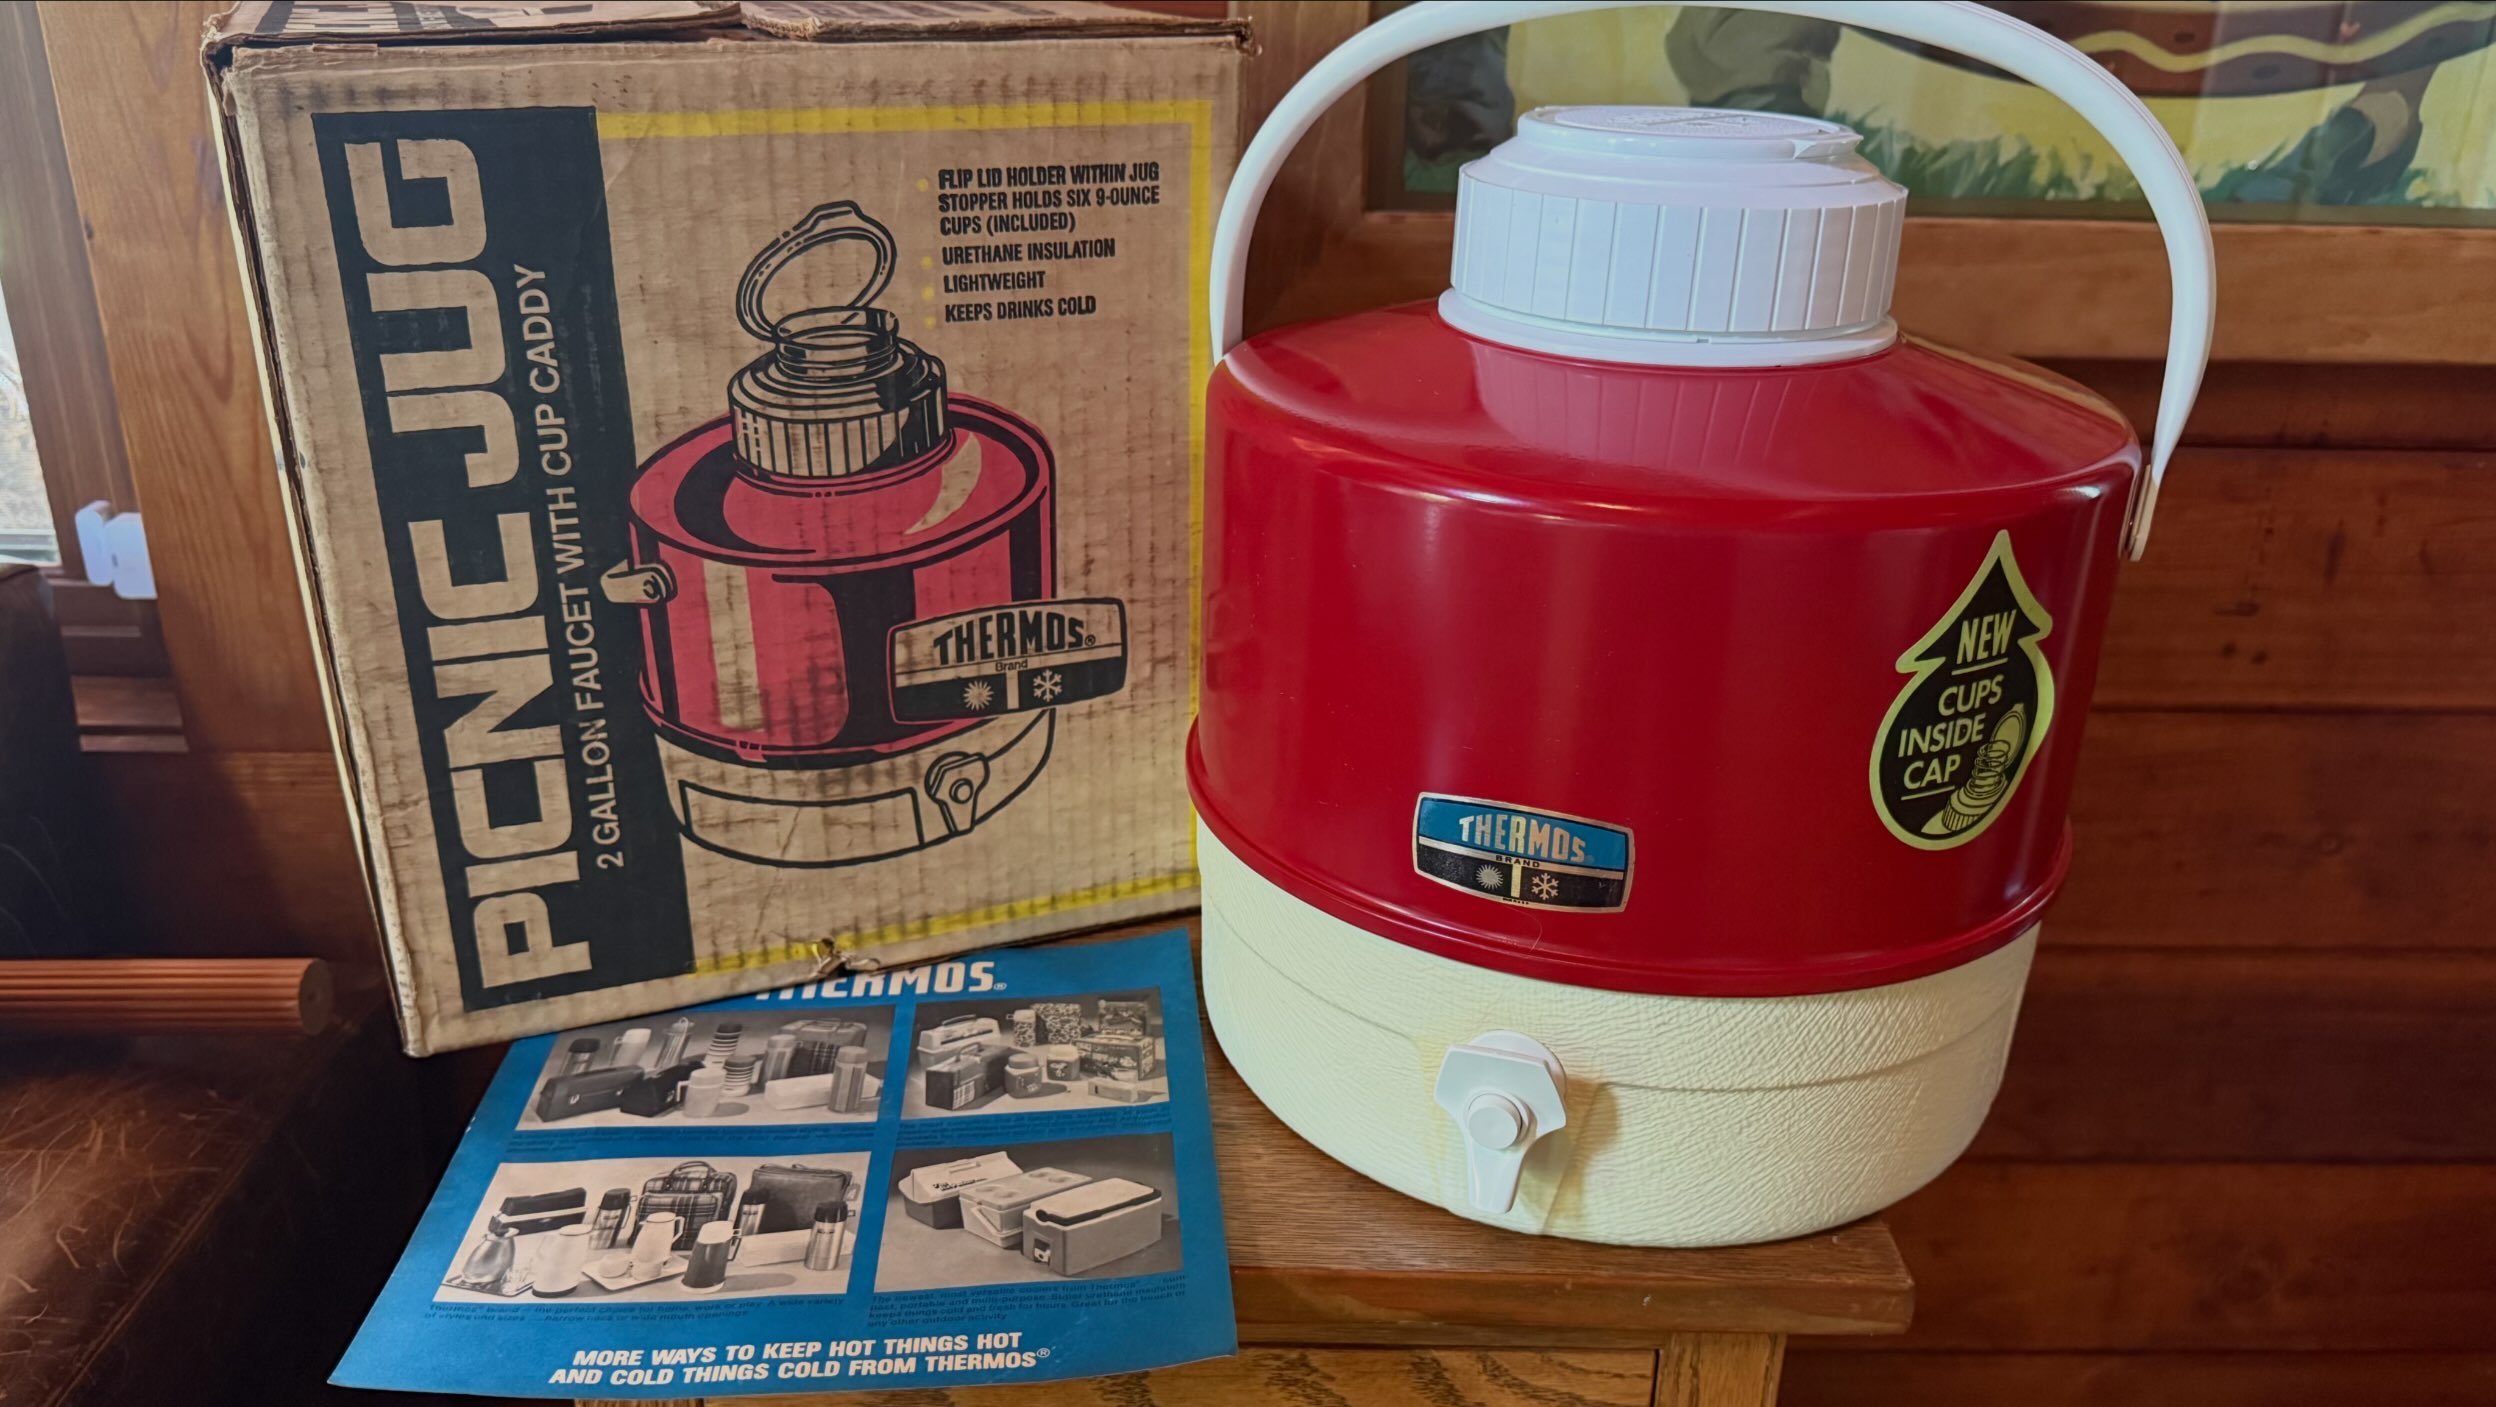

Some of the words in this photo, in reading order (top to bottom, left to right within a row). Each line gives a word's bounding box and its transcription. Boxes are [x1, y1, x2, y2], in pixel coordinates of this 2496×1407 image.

[938, 168, 972, 190] FLIP
[977, 167, 1003, 188] LID
[1007, 165, 1066, 187] HOLDER
[1070, 163, 1126, 184] WITHIN
[1129, 161, 1159, 182] JUG
[938, 191, 1008, 213] STOPPER
[1012, 189, 1062, 210] HOLDS
[1066, 187, 1091, 208] SIX
[1095, 185, 1160, 207] 9-OUNCE
[940, 215, 982, 236] CUPS
[986, 212, 1076, 237] (INCLUDED)
[942, 243, 1023, 266] URETHANE
[1027, 238, 1116, 262] INSULATION
[943, 270, 1046, 293] LIGHTWEIGHT
[344, 138, 520, 488] JUG
[945, 303, 992, 323] KEEPS
[997, 298, 1054, 321] DRINKS
[1058, 295, 1096, 316] COLD
[513, 263, 561, 394] CADDY
[534, 403, 573, 477] CUP
[546, 485, 582, 574] WITH
[558, 583, 606, 712] FAUCET
[1956, 609, 2017, 666] NEW
[995, 660, 1028, 672] Brand
[1938, 674, 2005, 717] CUPS
[408, 512, 593, 989] PICNIC
[1898, 713, 1987, 758] INSIDE
[574, 716, 621, 846] GALLON
[1903, 754, 1961, 790] CAP
[596, 844, 625, 870] 2
[1495, 855, 1540, 868] BRAND
[572, 1350, 645, 1367] MORE
[651, 1346, 717, 1366] WAYS
[725, 1344, 755, 1361] TO
[762, 1341, 822, 1359] KEEP
[828, 1339, 877, 1357] HOT
[884, 1335, 969, 1355] THINGS
[976, 1331, 1023, 1350] HOT
[548, 1368, 603, 1384] AND
[610, 1368, 674, 1385] COLD
[682, 1362, 770, 1383] THINGS
[777, 1360, 840, 1379] COLD
[848, 1357, 916, 1377] FROM
